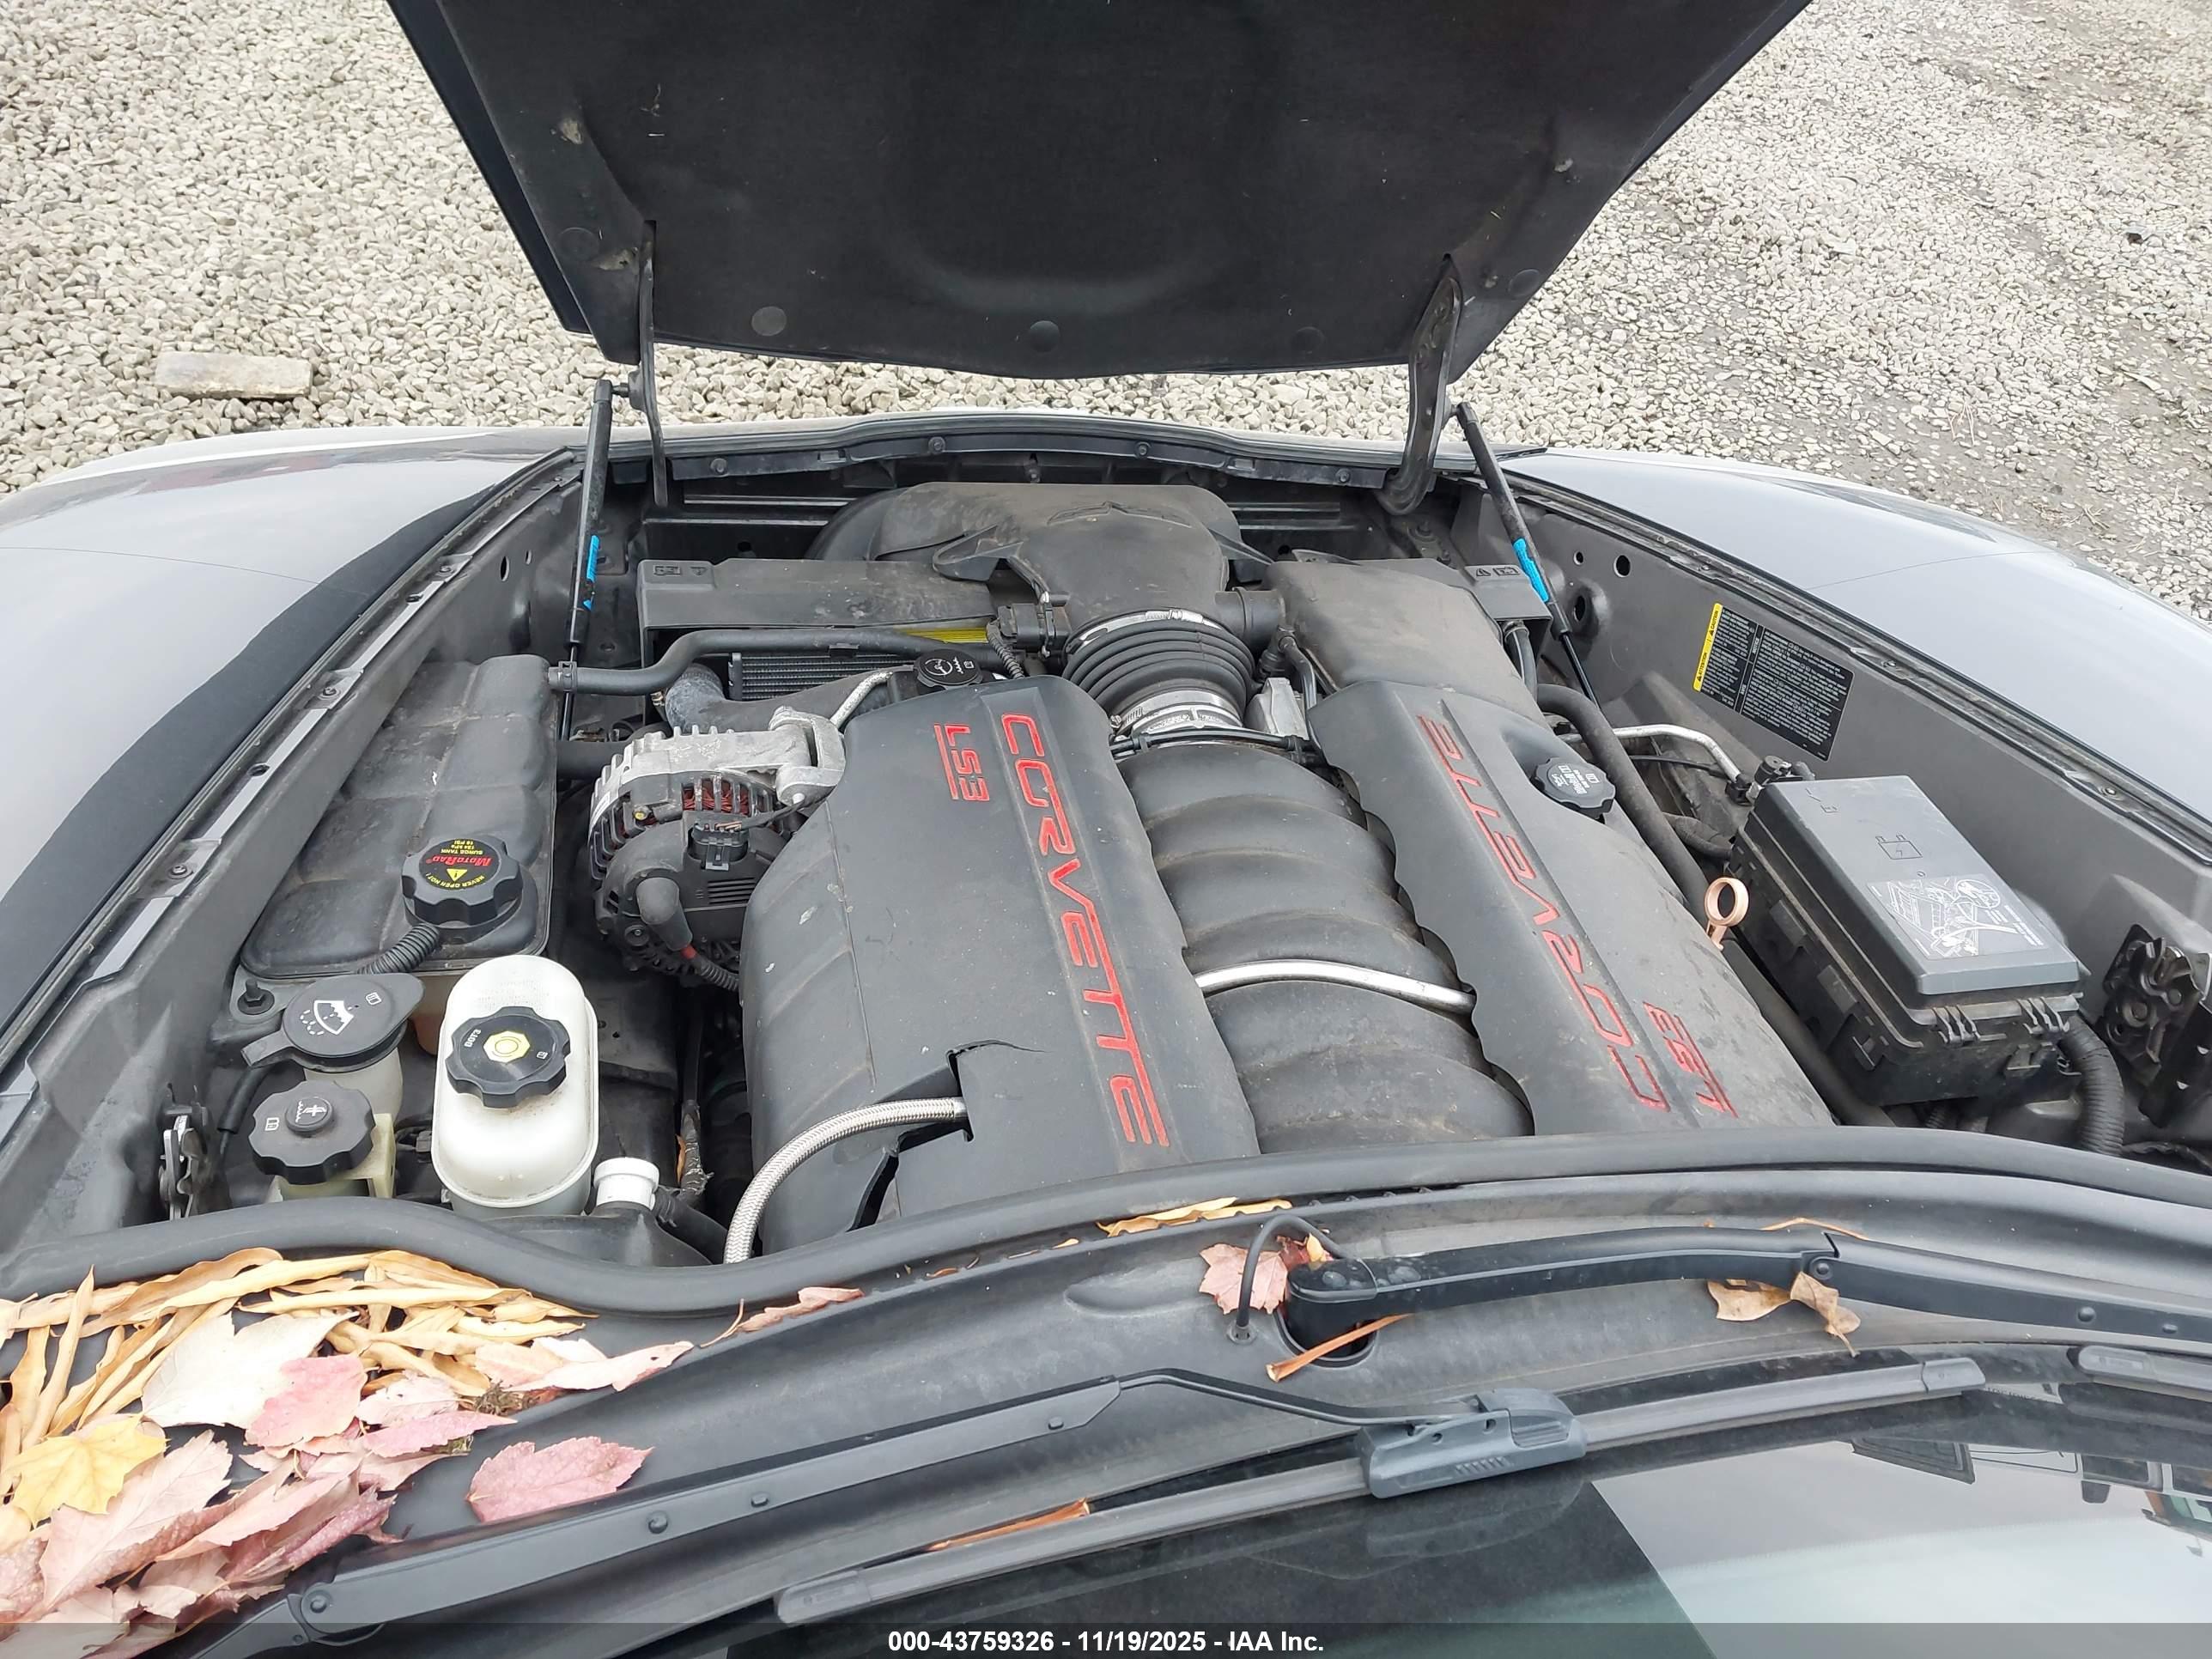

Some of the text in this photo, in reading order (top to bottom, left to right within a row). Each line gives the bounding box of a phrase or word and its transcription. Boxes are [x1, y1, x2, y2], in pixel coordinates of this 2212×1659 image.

[1711, 611, 1719, 629] CAUTION
[944, 723, 990, 802] LS3
[1000, 712, 1170, 1148] CORVETTE
[1416, 714, 1672, 1113] CORVETTE
